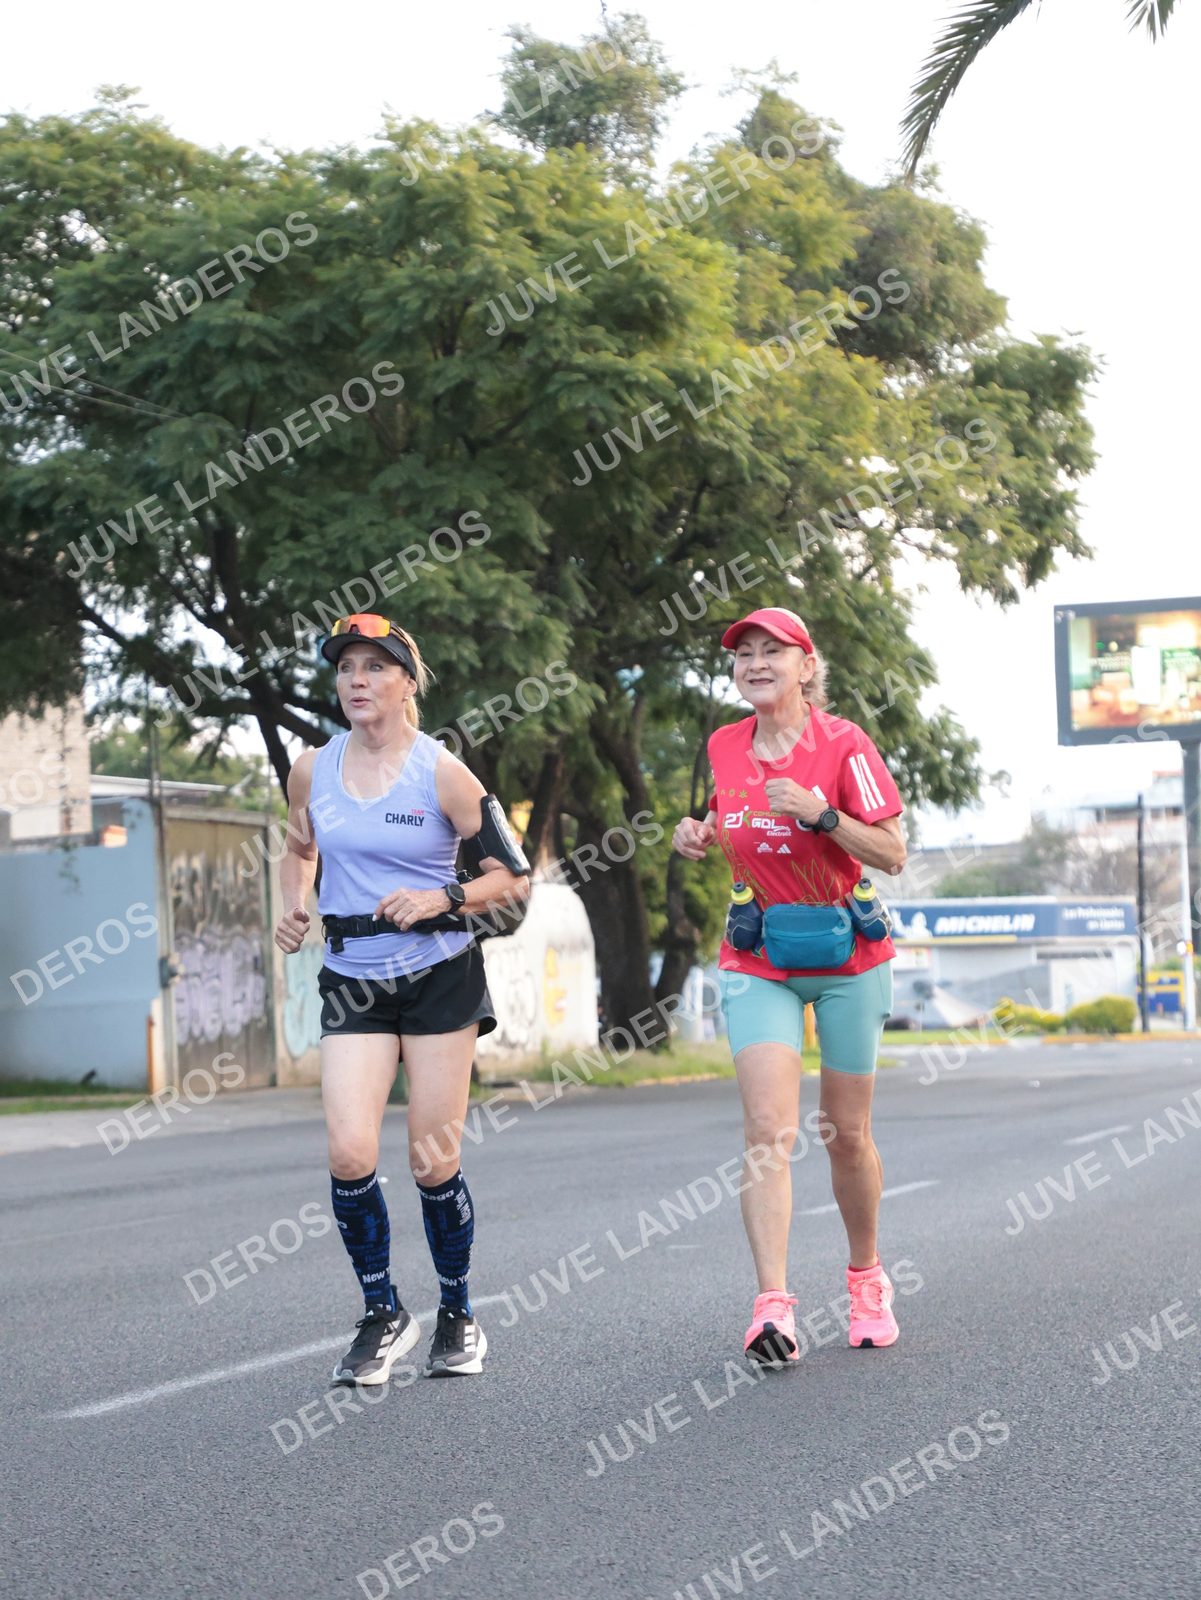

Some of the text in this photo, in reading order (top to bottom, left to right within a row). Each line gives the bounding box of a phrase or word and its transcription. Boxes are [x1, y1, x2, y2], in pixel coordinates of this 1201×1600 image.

[385, 812, 425, 827] CHARLY
[751, 818, 778, 829] GDL
[934, 913, 1036, 935] MICHELIN
[362, 1270, 385, 1284] New
